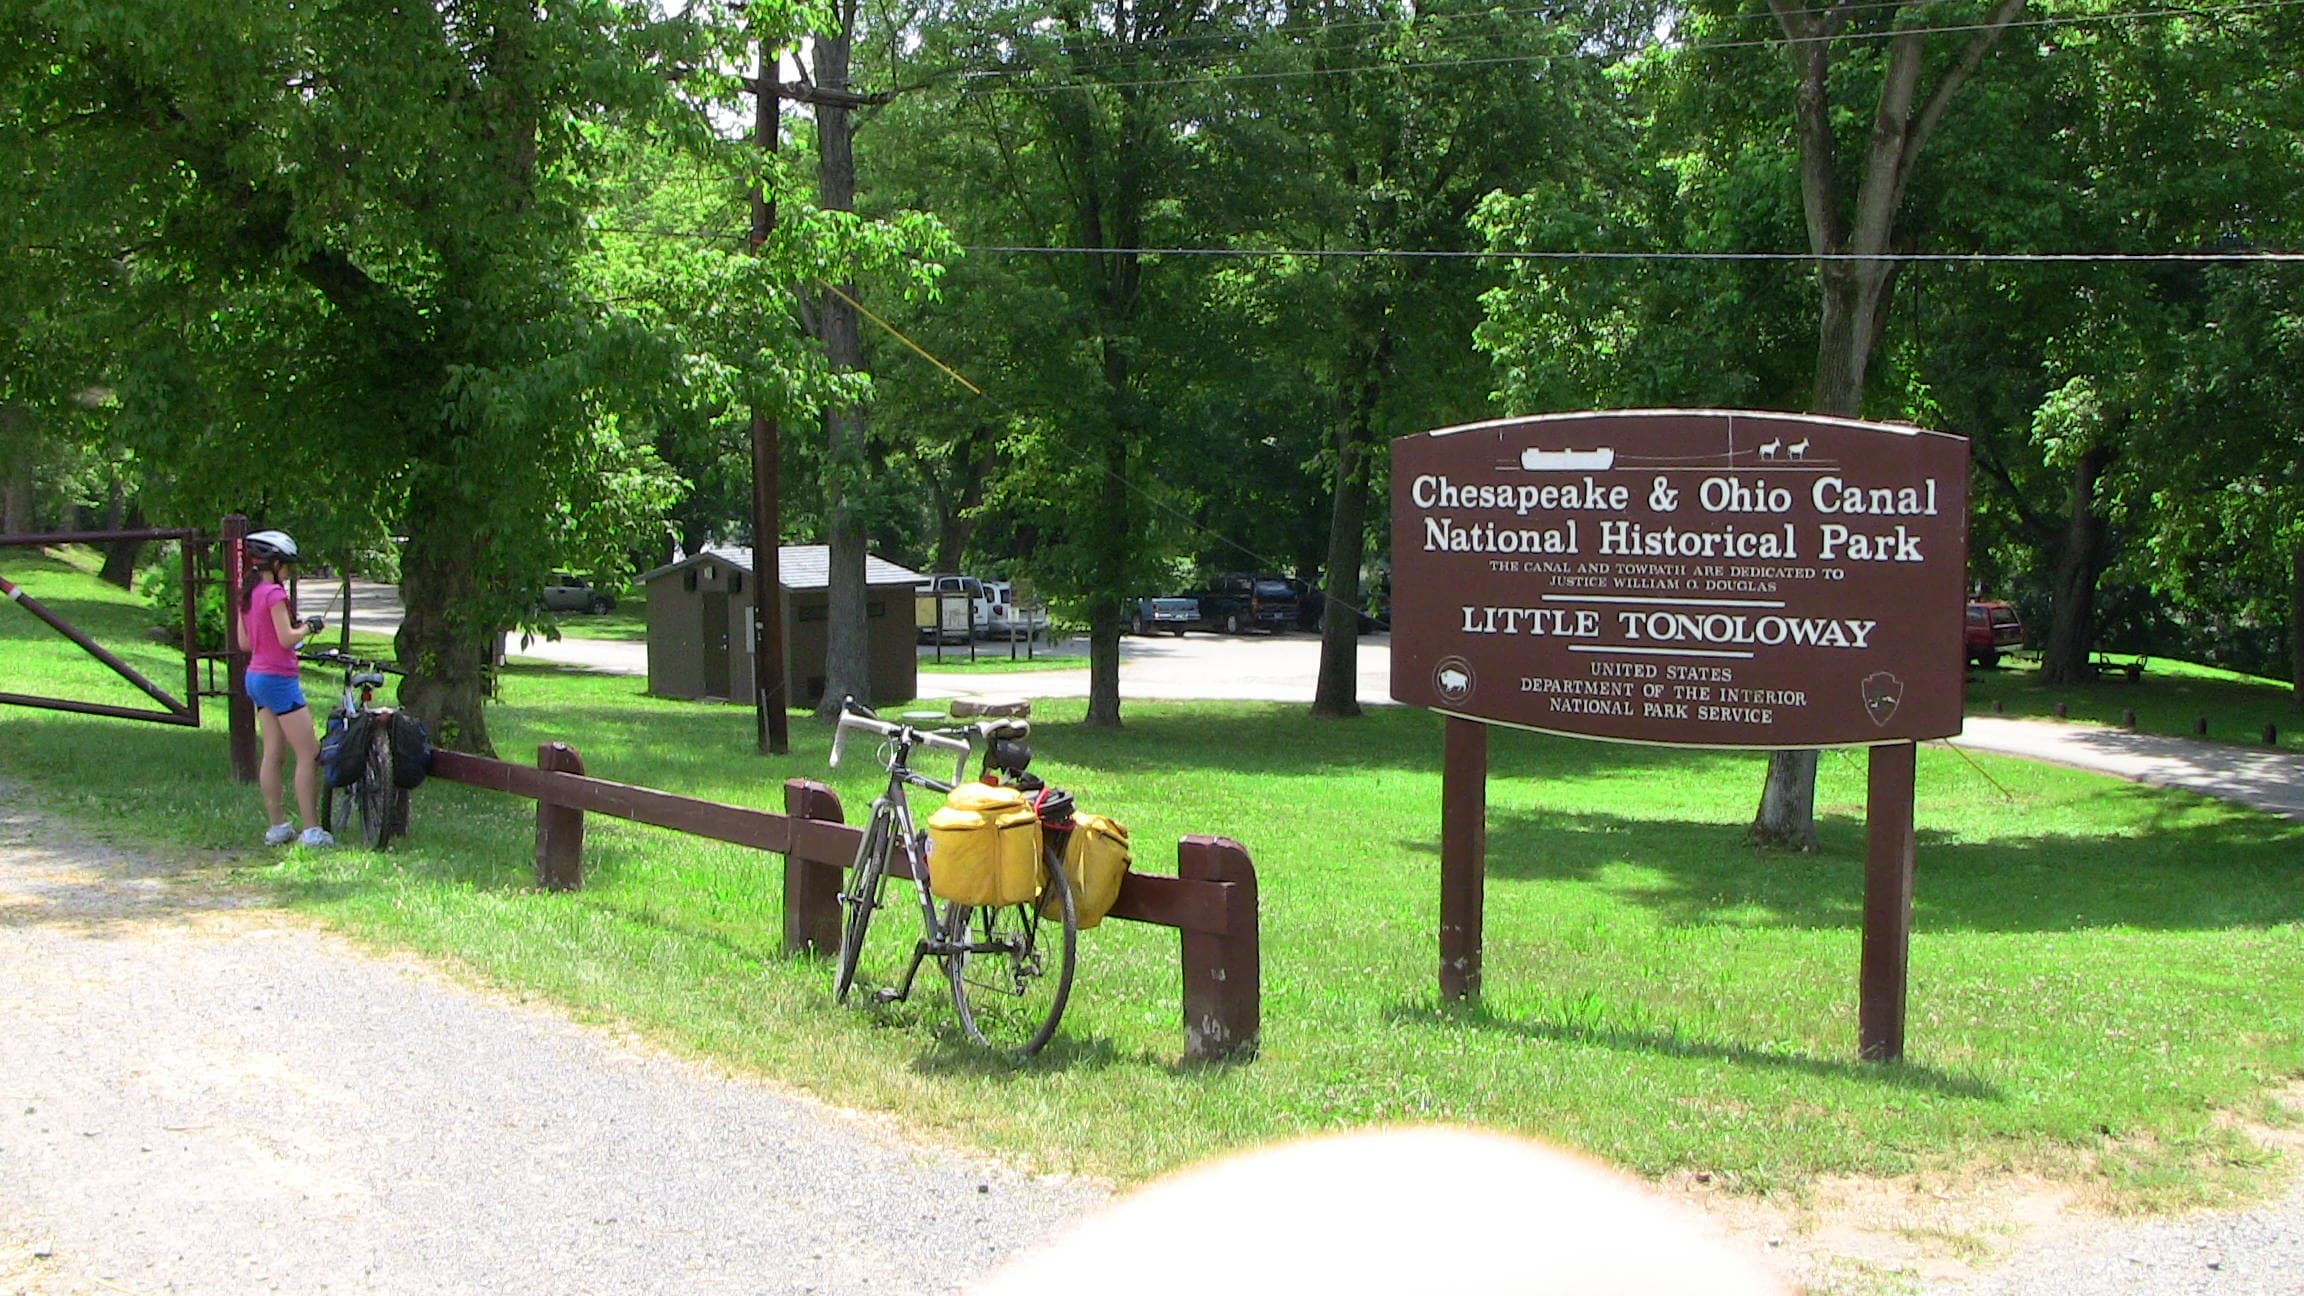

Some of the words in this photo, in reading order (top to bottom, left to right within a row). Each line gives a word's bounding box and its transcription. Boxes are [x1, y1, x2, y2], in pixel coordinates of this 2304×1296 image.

[1412, 475, 1629, 515] Chesapeake
[1648, 475, 1679, 512] &
[1700, 477, 1792, 513] Ohio
[1812, 476, 1938, 515] Canal
[1424, 517, 1579, 554] National
[1600, 520, 1797, 559] Historical
[1819, 524, 1924, 562] Park
[1490, 561, 1519, 572] THE
[1524, 561, 1571, 574] CANAL
[1577, 562, 1610, 574] AND
[1616, 563, 1686, 576] TOWPATH
[1693, 565, 1724, 577] ARE
[1730, 566, 1816, 580] DEDICATED
[1822, 568, 1845, 580] TO
[1549, 575, 1607, 588] JUSTICE
[1614, 576, 1680, 590] WILLIAM
[1706, 580, 1777, 593] DOUGLAS
[1461, 606, 1600, 638] LITTLE
[1618, 611, 1876, 648] TONOLOWAY
[1591, 661, 1658, 678] UNITED
[1666, 665, 1732, 681] STATES
[1520, 677, 1634, 697] DEPARTMENT
[1643, 683, 1665, 698] OF
[1673, 685, 1711, 701] THE
[1720, 687, 1808, 706] INTERIOR
[1550, 697, 1634, 717] NATIONAL
[1643, 701, 1689, 719] PARK
[1698, 706, 1774, 724] SERVICE
